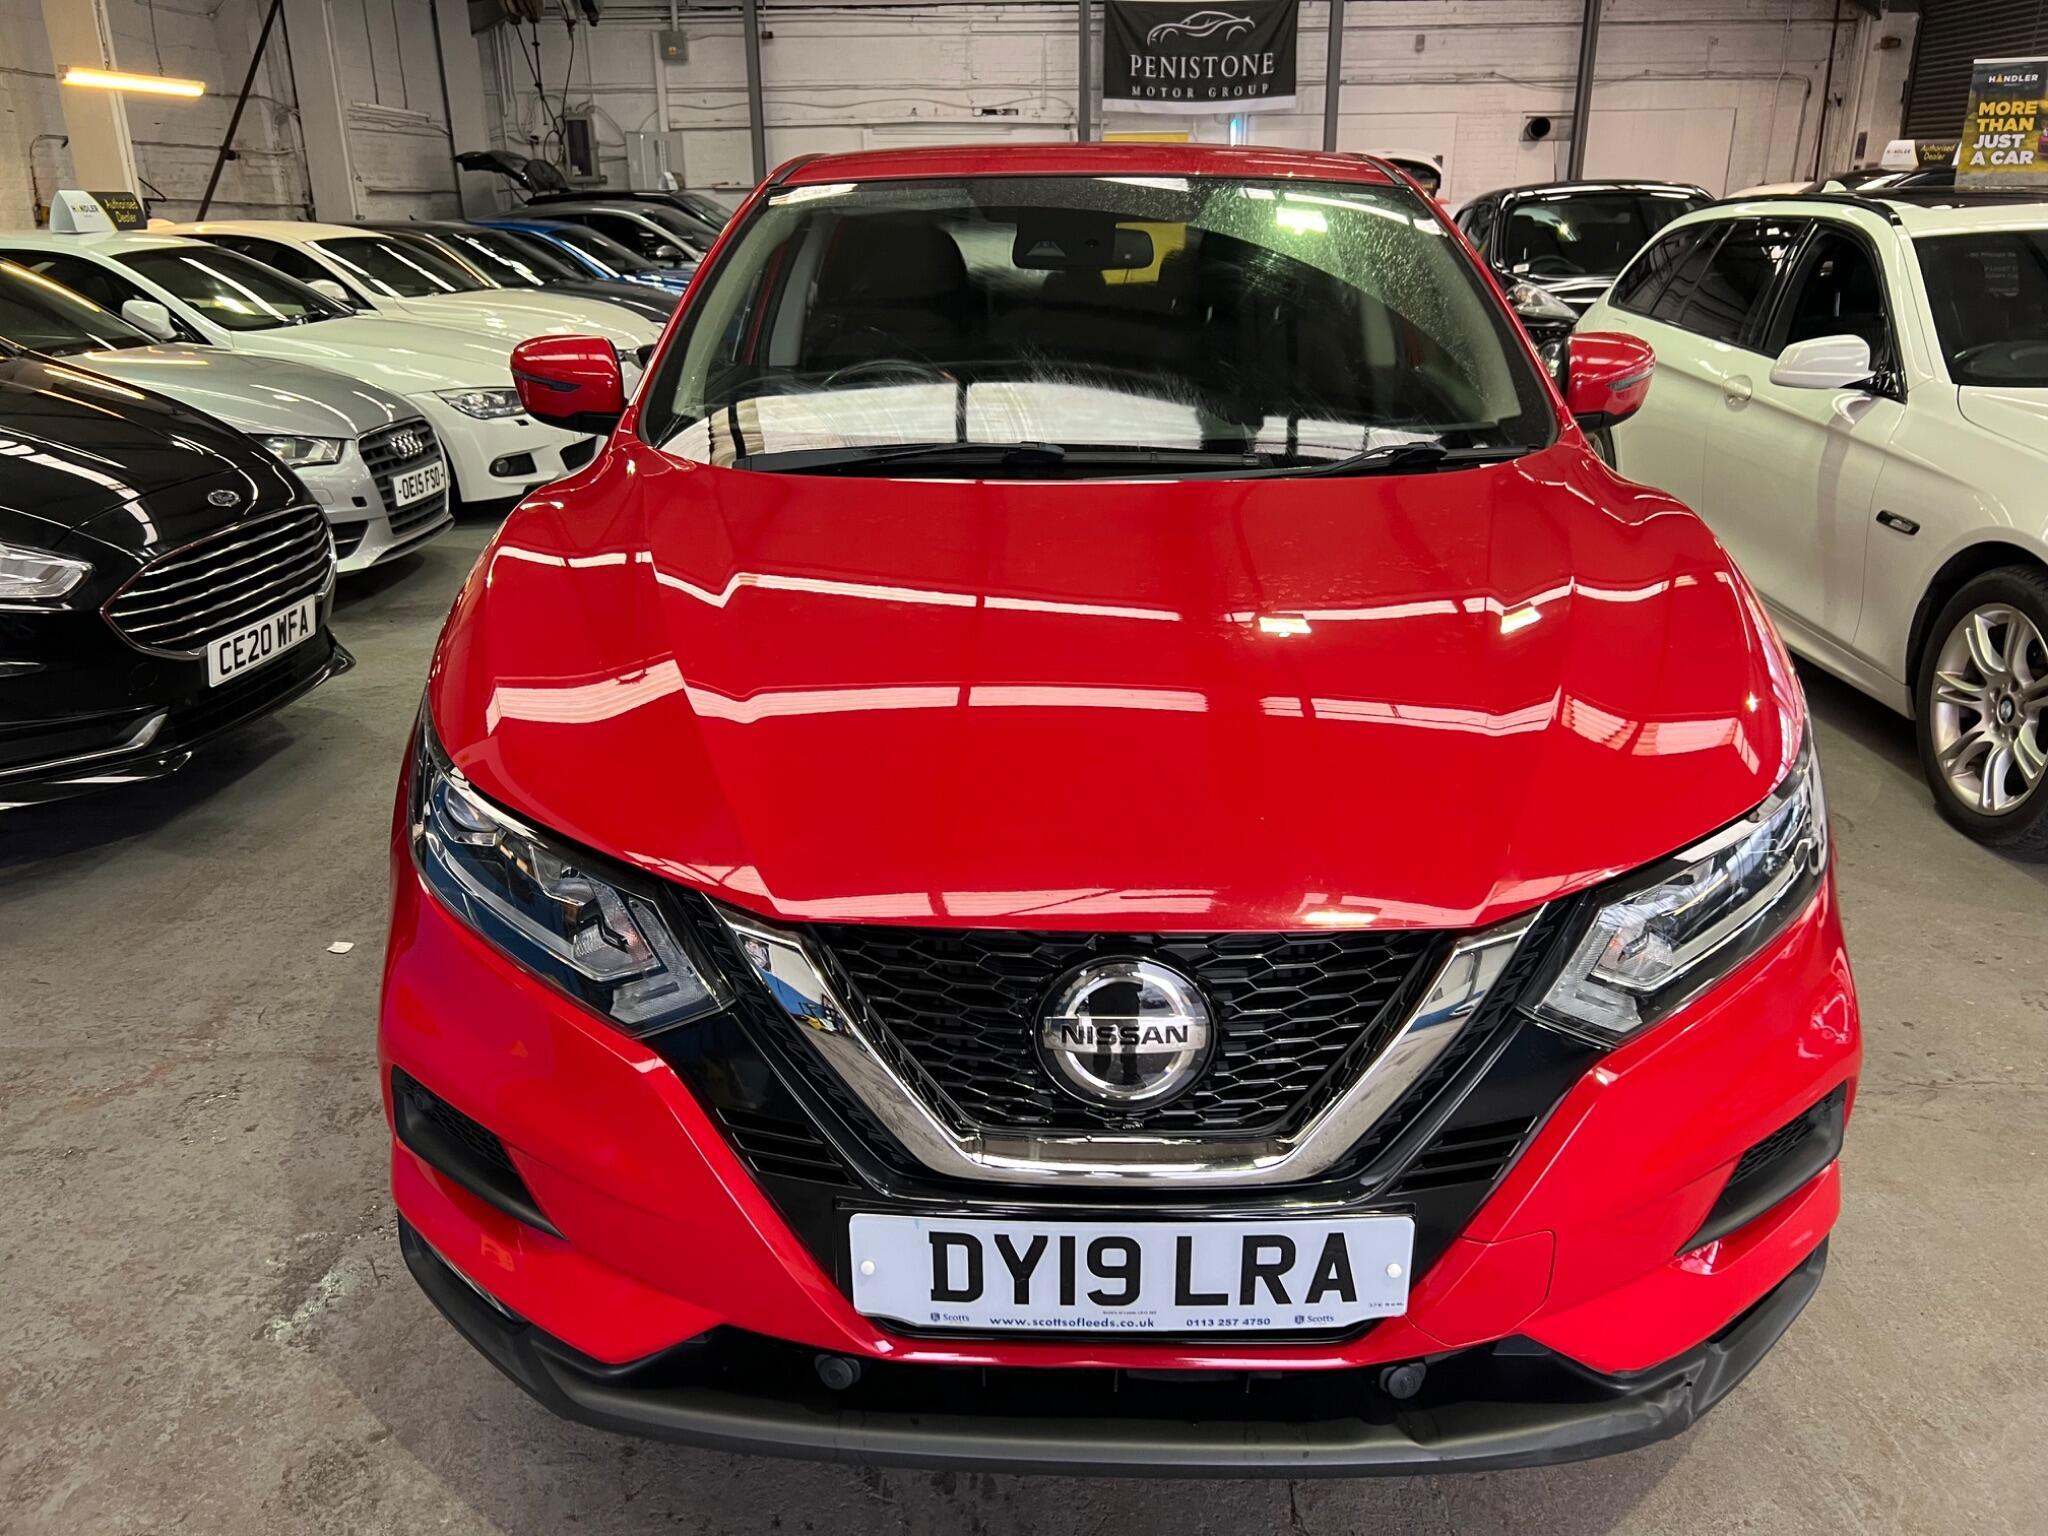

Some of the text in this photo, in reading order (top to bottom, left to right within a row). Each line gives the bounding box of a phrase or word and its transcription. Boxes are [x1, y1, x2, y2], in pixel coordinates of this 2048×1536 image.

[1130, 53, 1275, 79] PENISTONE
[1132, 83, 1270, 99] MOTOR GROUP
[1978, 101, 2038, 116] MORE
[1976, 117, 2035, 132] THAN
[1973, 134, 2025, 149] JUST
[1923, 152, 1946, 160] Dealer
[1970, 150, 2034, 166] A CAR
[115, 210, 137, 223] Dealer
[402, 474, 424, 499] OE15
[219, 605, 309, 676] CE20 WFA
[1061, 1025, 1188, 1045] NISSAN
[929, 1231, 1358, 1306] DY19 LRA
[943, 1312, 970, 1322] Scotts
[990, 1317, 1154, 1328] www.scottsofleeds.co.uk
[1186, 1318, 1271, 1327] 0113 257 4750
[1307, 1314, 1335, 1323] Scotts
